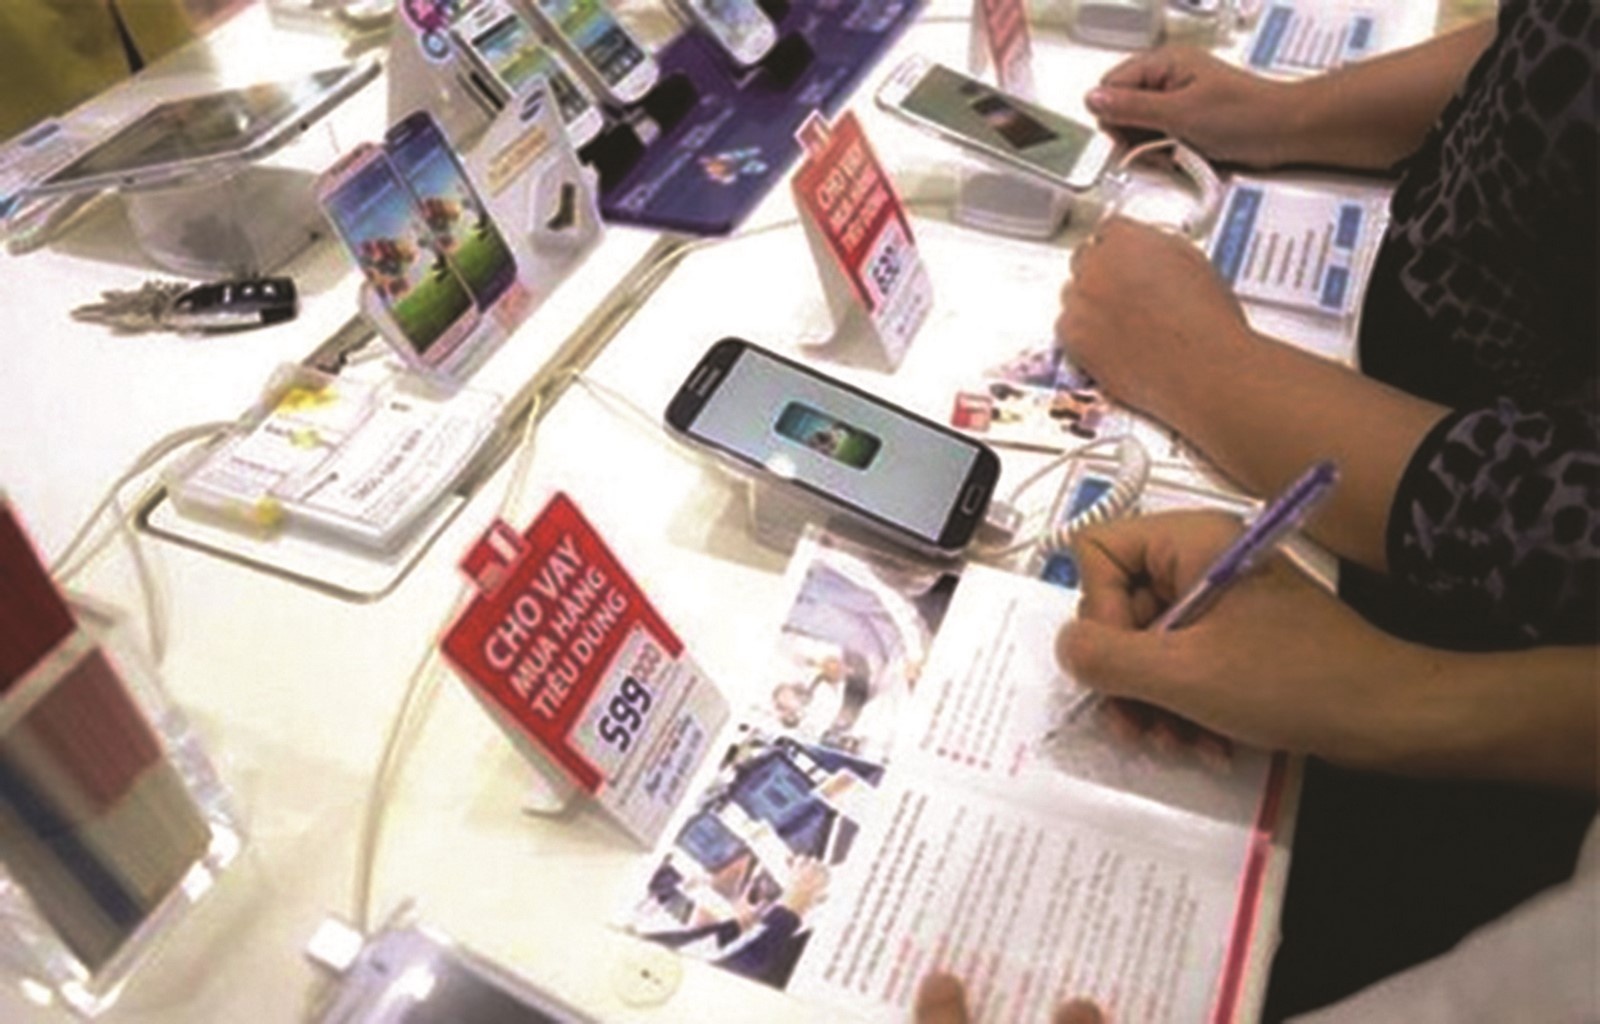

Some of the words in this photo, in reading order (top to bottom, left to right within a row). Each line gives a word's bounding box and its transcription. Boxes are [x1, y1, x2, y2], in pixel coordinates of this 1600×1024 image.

[485, 594, 543, 670] CHO
[531, 535, 583, 600] VAY
[510, 636, 560, 699] MUA
[598, 676, 652, 753] 599
